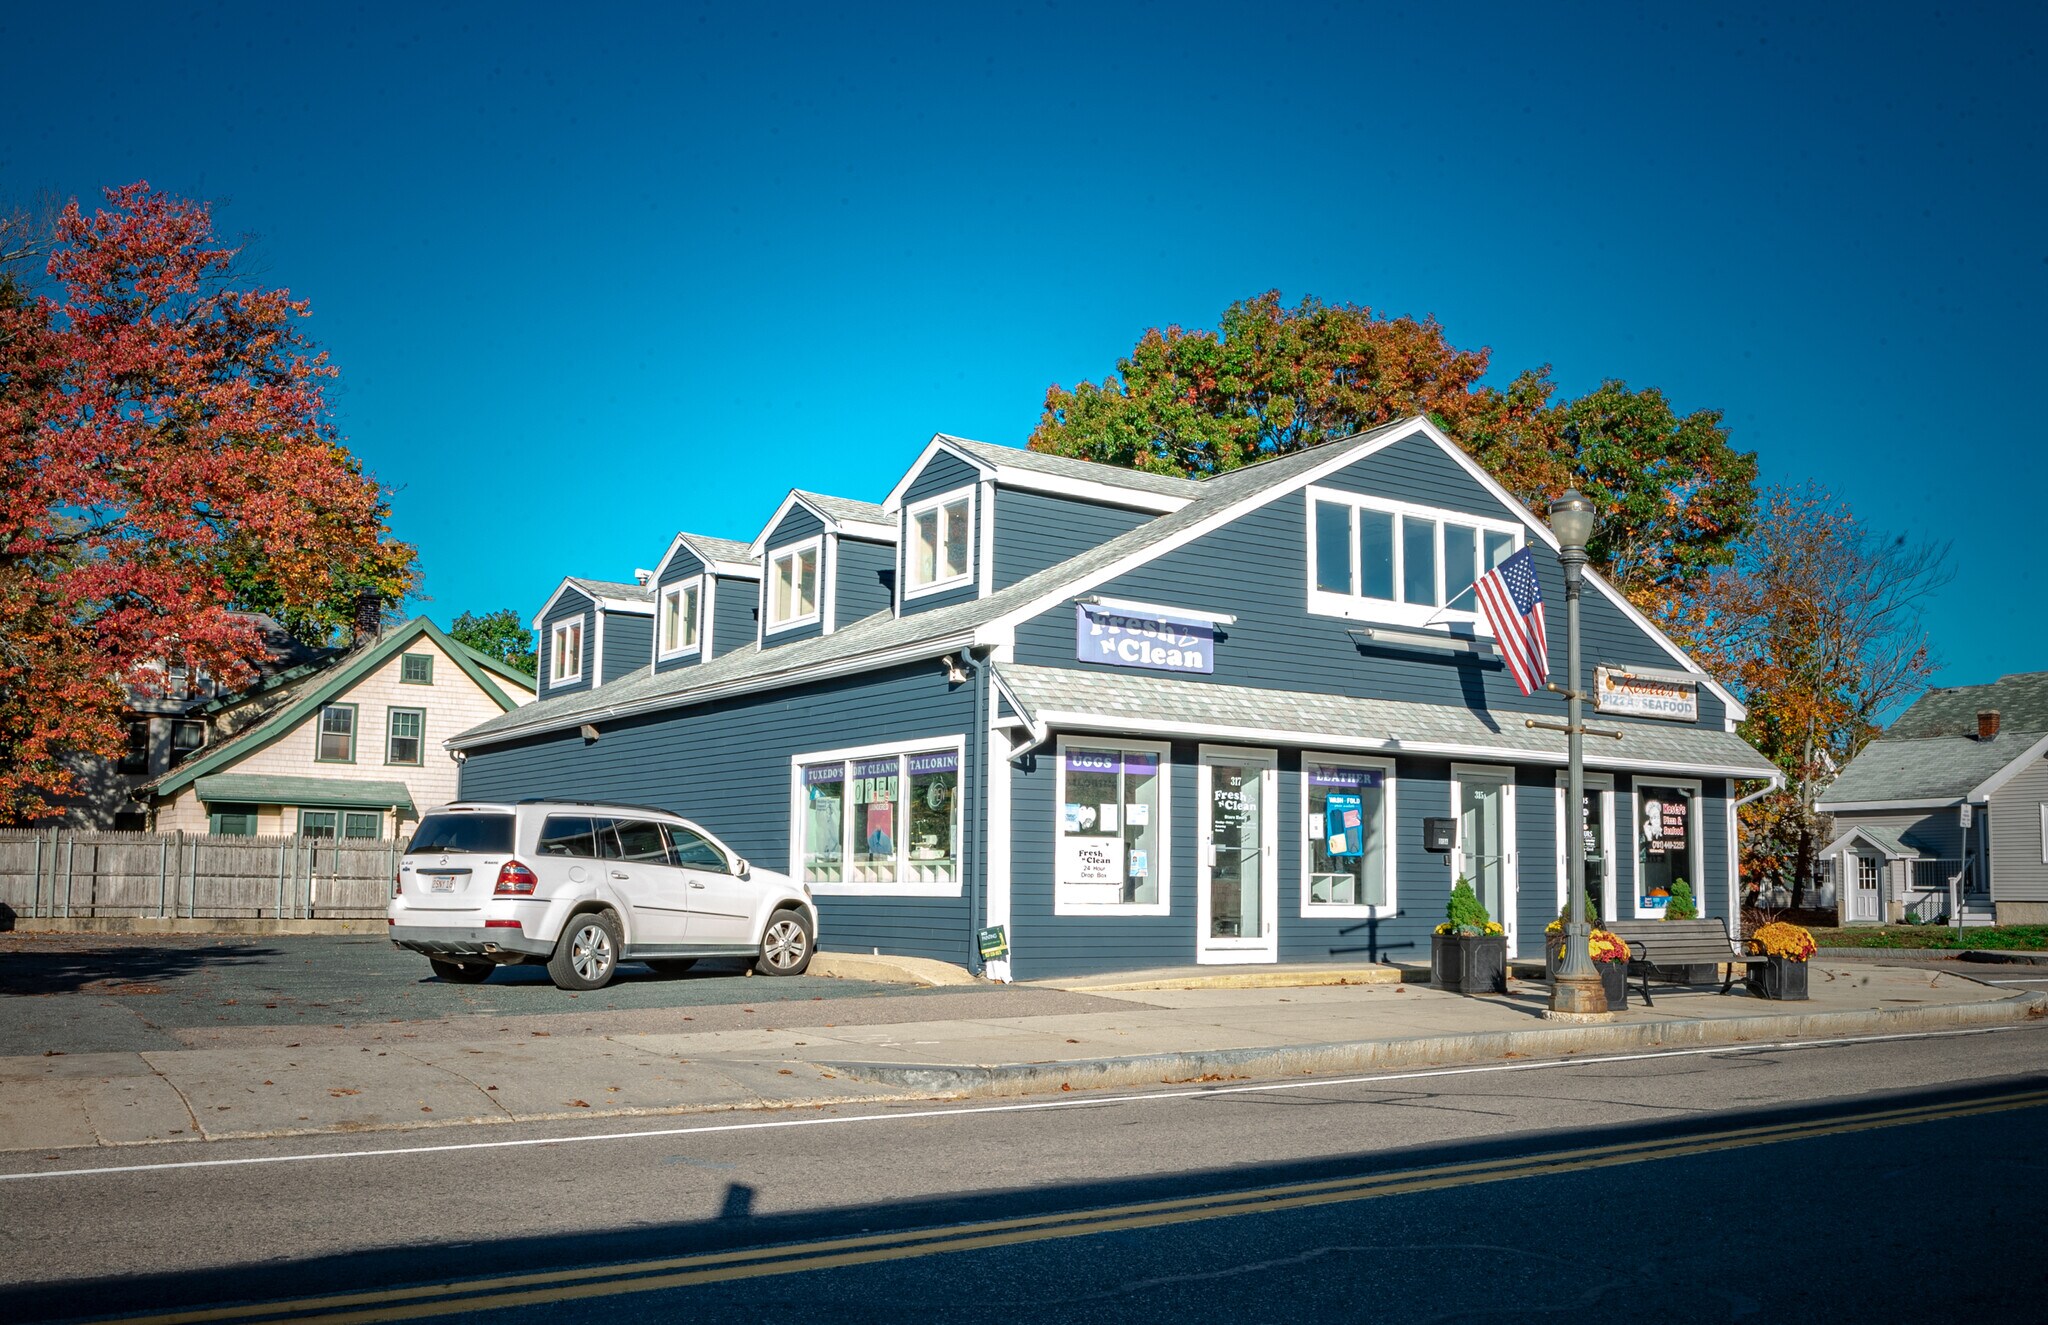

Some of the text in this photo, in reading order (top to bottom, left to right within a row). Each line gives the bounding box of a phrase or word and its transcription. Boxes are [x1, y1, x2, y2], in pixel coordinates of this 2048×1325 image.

[1090, 611, 1175, 645] Fresh
[1117, 638, 1204, 668] Clean
[1620, 673, 1675, 698] Kosta's
[1602, 694, 1693, 713] PIZZA SEAFOOD
[853, 761, 898, 776] DRY CLEANIN
[1072, 755, 1112, 769] UGGS
[808, 767, 844, 781] TUXEDO'S
[1230, 776, 1242, 786] 317
[1316, 771, 1372, 784] LEATHER
[855, 780, 896, 801] OPEN
[1214, 789, 1247, 802] Fresh
[1224, 799, 1257, 811] Clean
[1079, 850, 1103, 858] Fresh
[1086, 856, 1111, 864] Clean
